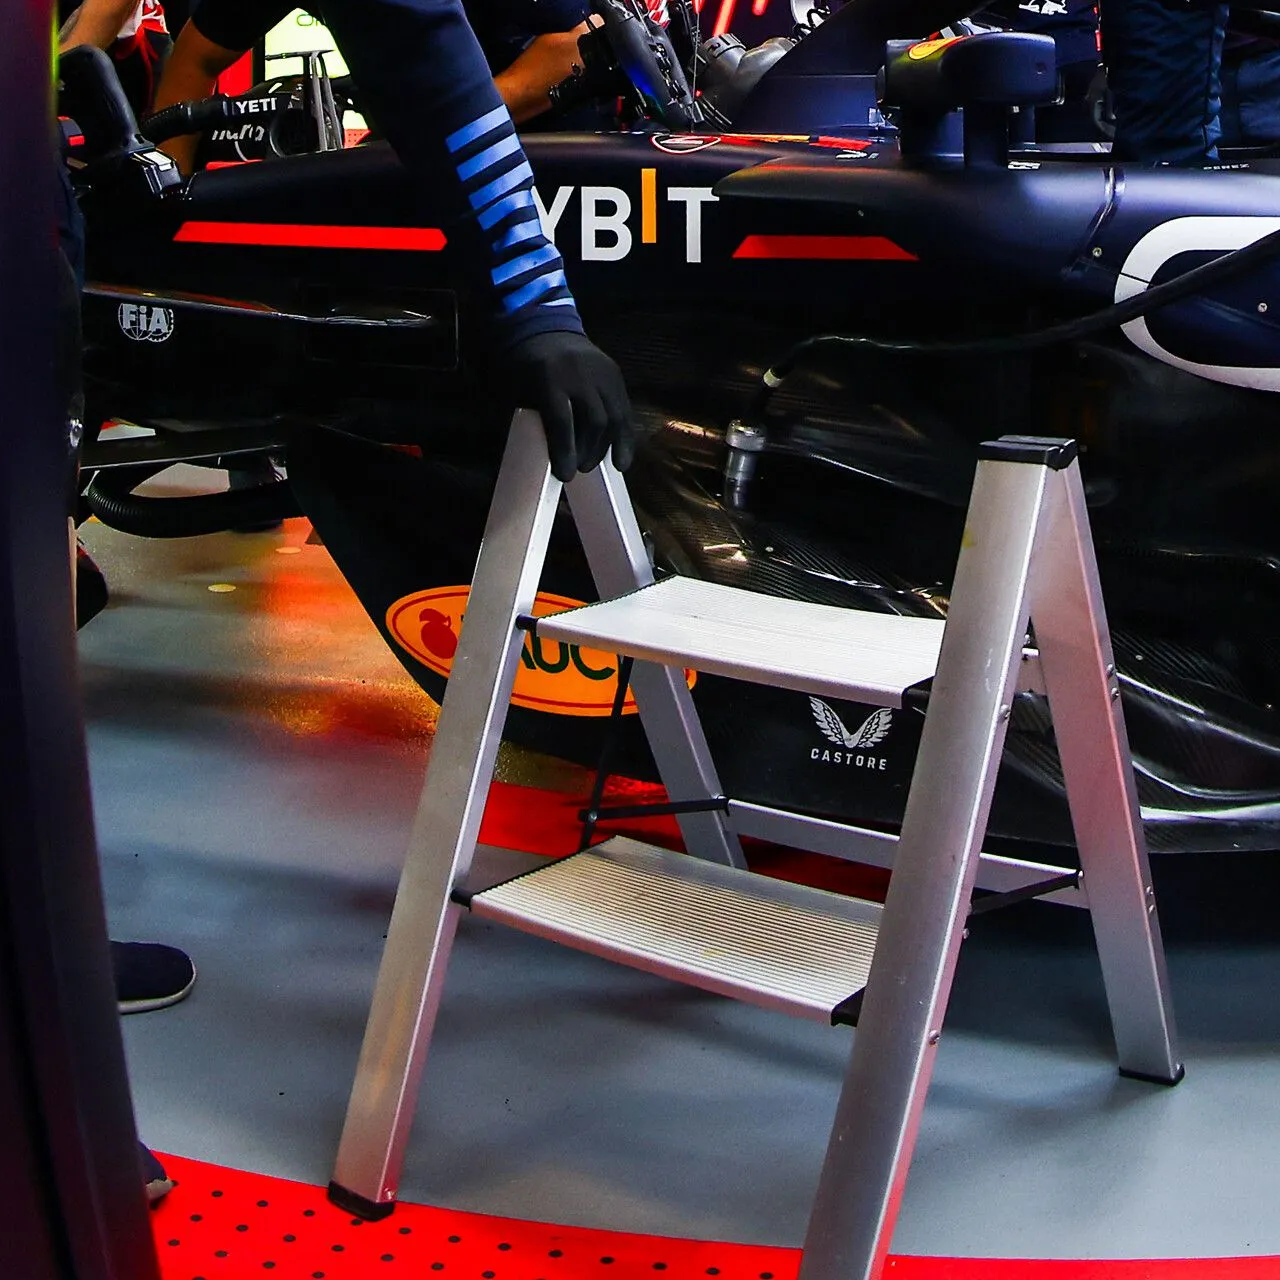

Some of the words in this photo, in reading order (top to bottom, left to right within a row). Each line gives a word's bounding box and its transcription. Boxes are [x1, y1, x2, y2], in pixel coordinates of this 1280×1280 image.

[235, 96, 278, 114] YETI
[534, 168, 720, 263] YBIT
[810, 748, 888, 771] CASTORE
